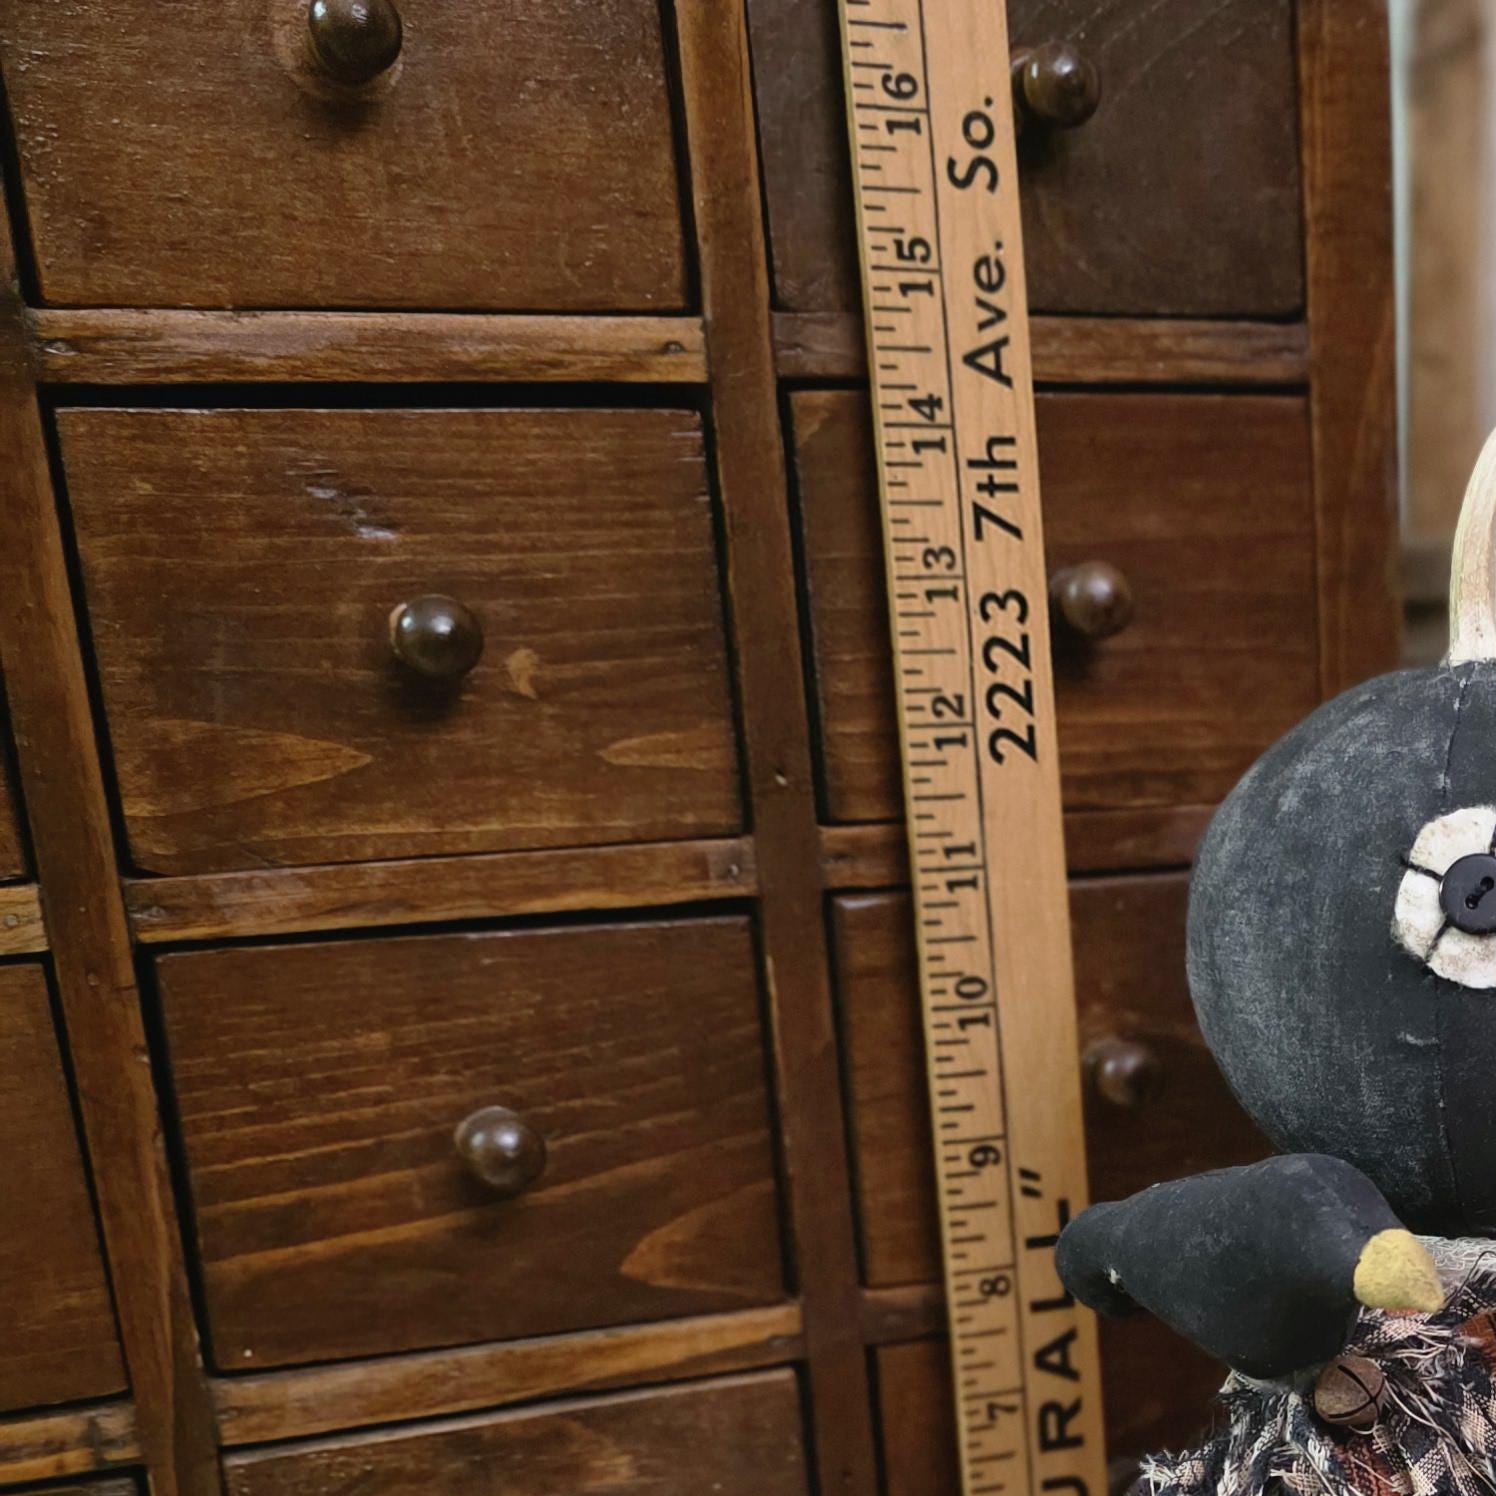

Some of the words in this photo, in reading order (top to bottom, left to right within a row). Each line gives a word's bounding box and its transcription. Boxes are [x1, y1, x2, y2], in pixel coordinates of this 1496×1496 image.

[882, 72, 921, 136] 16
[947, 96, 999, 194] So.
[895, 237, 934, 297] 15
[962, 240, 1013, 389] Ave.
[908, 394, 946, 454] 14
[967, 435, 1024, 541] 7th
[922, 546, 959, 604] 13
[979, 589, 1038, 765] 2223
[931, 693, 967, 752] 12
[943, 841, 979, 893] 11
[954, 976, 991, 1031] 10
[968, 1145, 1000, 1168] 9
[979, 1275, 1011, 1297] 8
[987, 1402, 1018, 1422] 7
